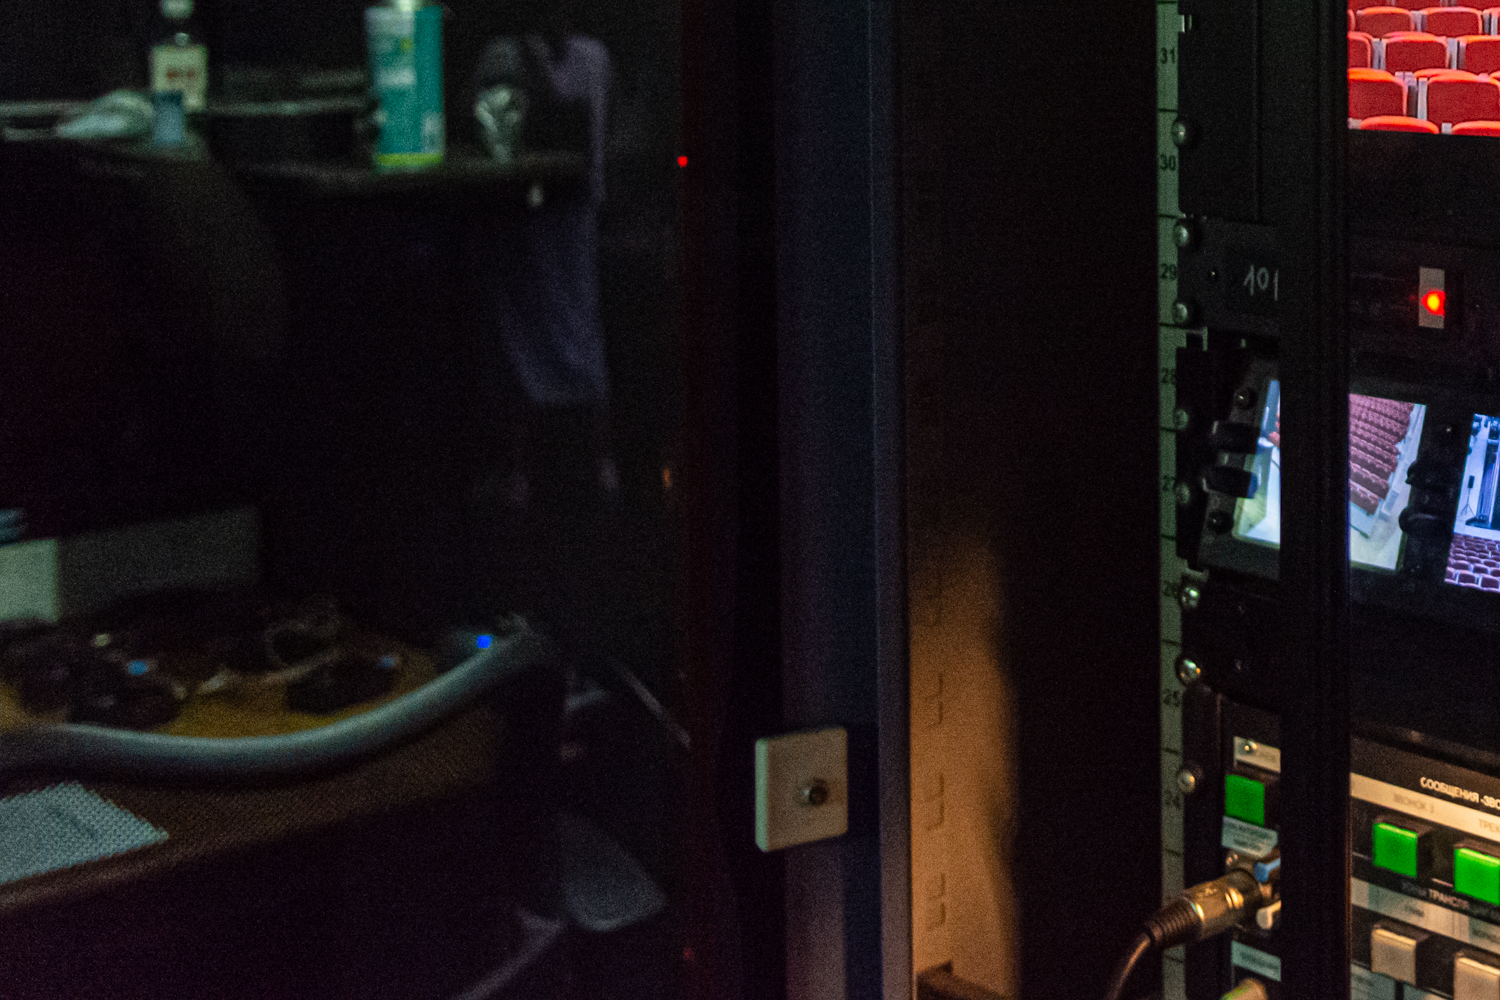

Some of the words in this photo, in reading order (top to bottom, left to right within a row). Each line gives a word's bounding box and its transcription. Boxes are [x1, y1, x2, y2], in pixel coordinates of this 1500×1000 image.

[1160, 47, 1176, 64] 31
[1159, 154, 1177, 171] 30
[1160, 263, 1178, 280] 29
